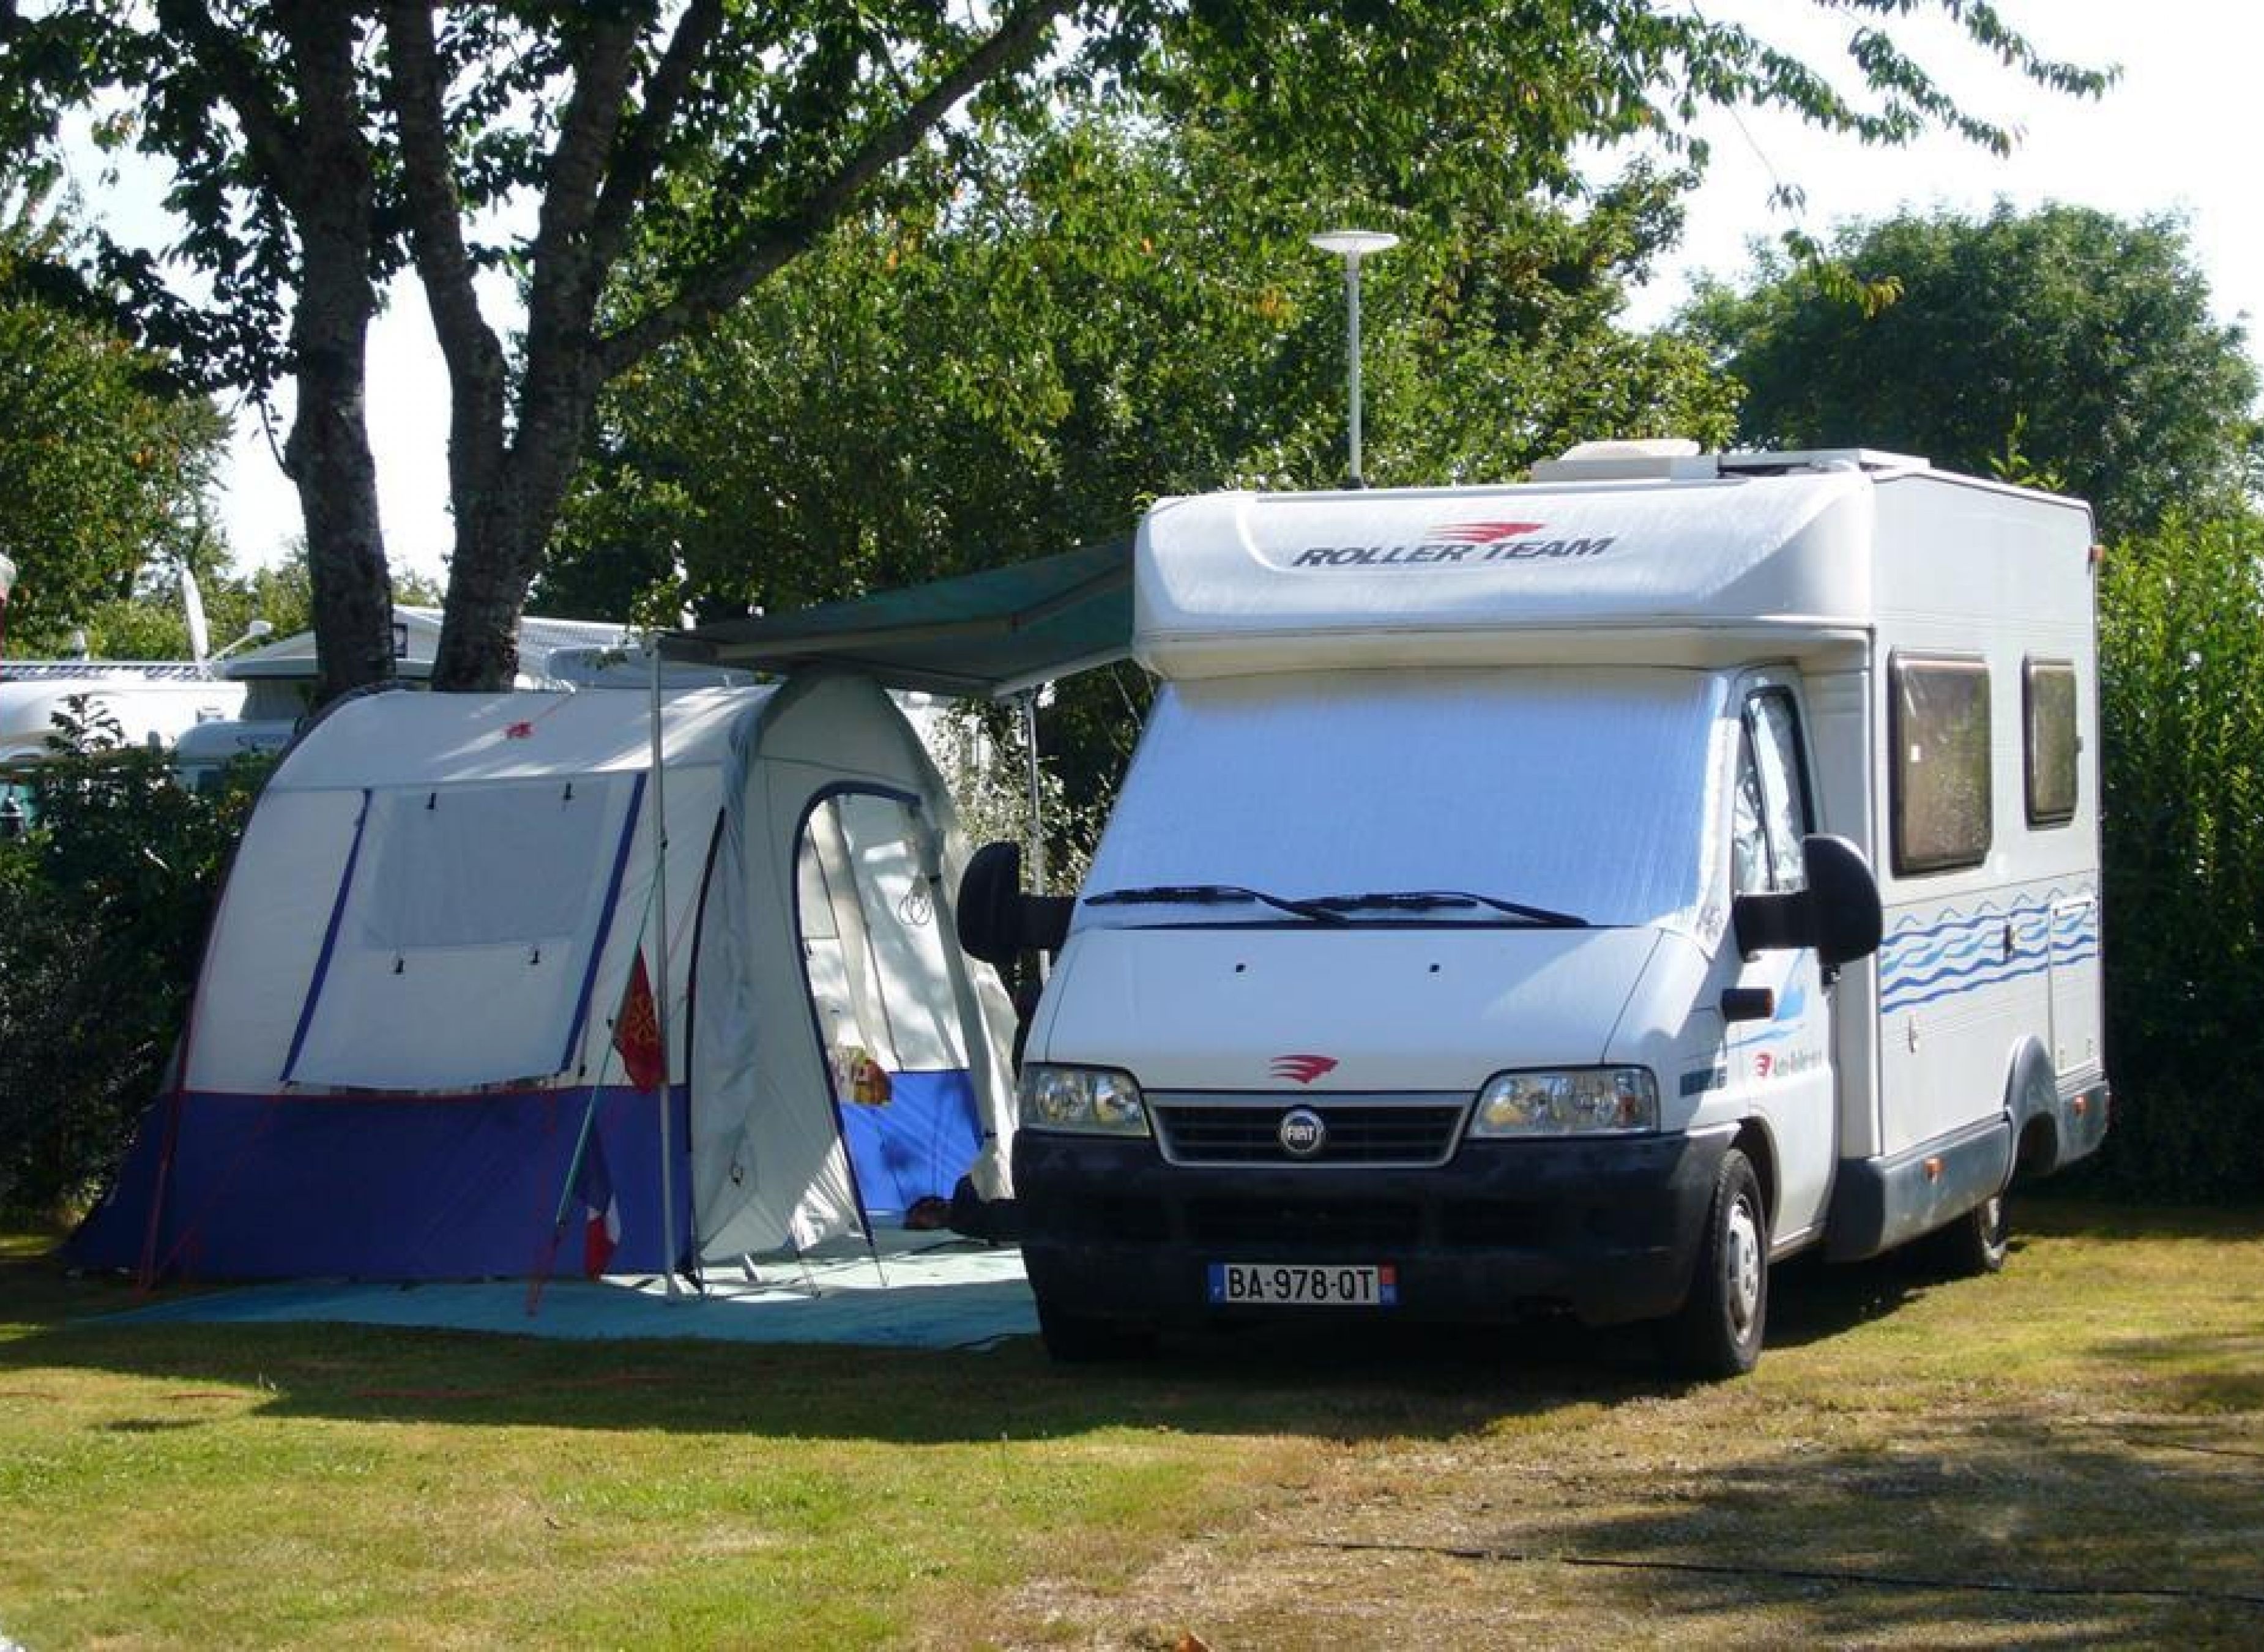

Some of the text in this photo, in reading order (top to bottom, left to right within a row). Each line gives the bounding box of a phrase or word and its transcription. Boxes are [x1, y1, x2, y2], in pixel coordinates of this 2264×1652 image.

[1292, 537, 1617, 567] ROLLER TEAM
[1228, 1267, 1374, 1300] BA-978-QT
